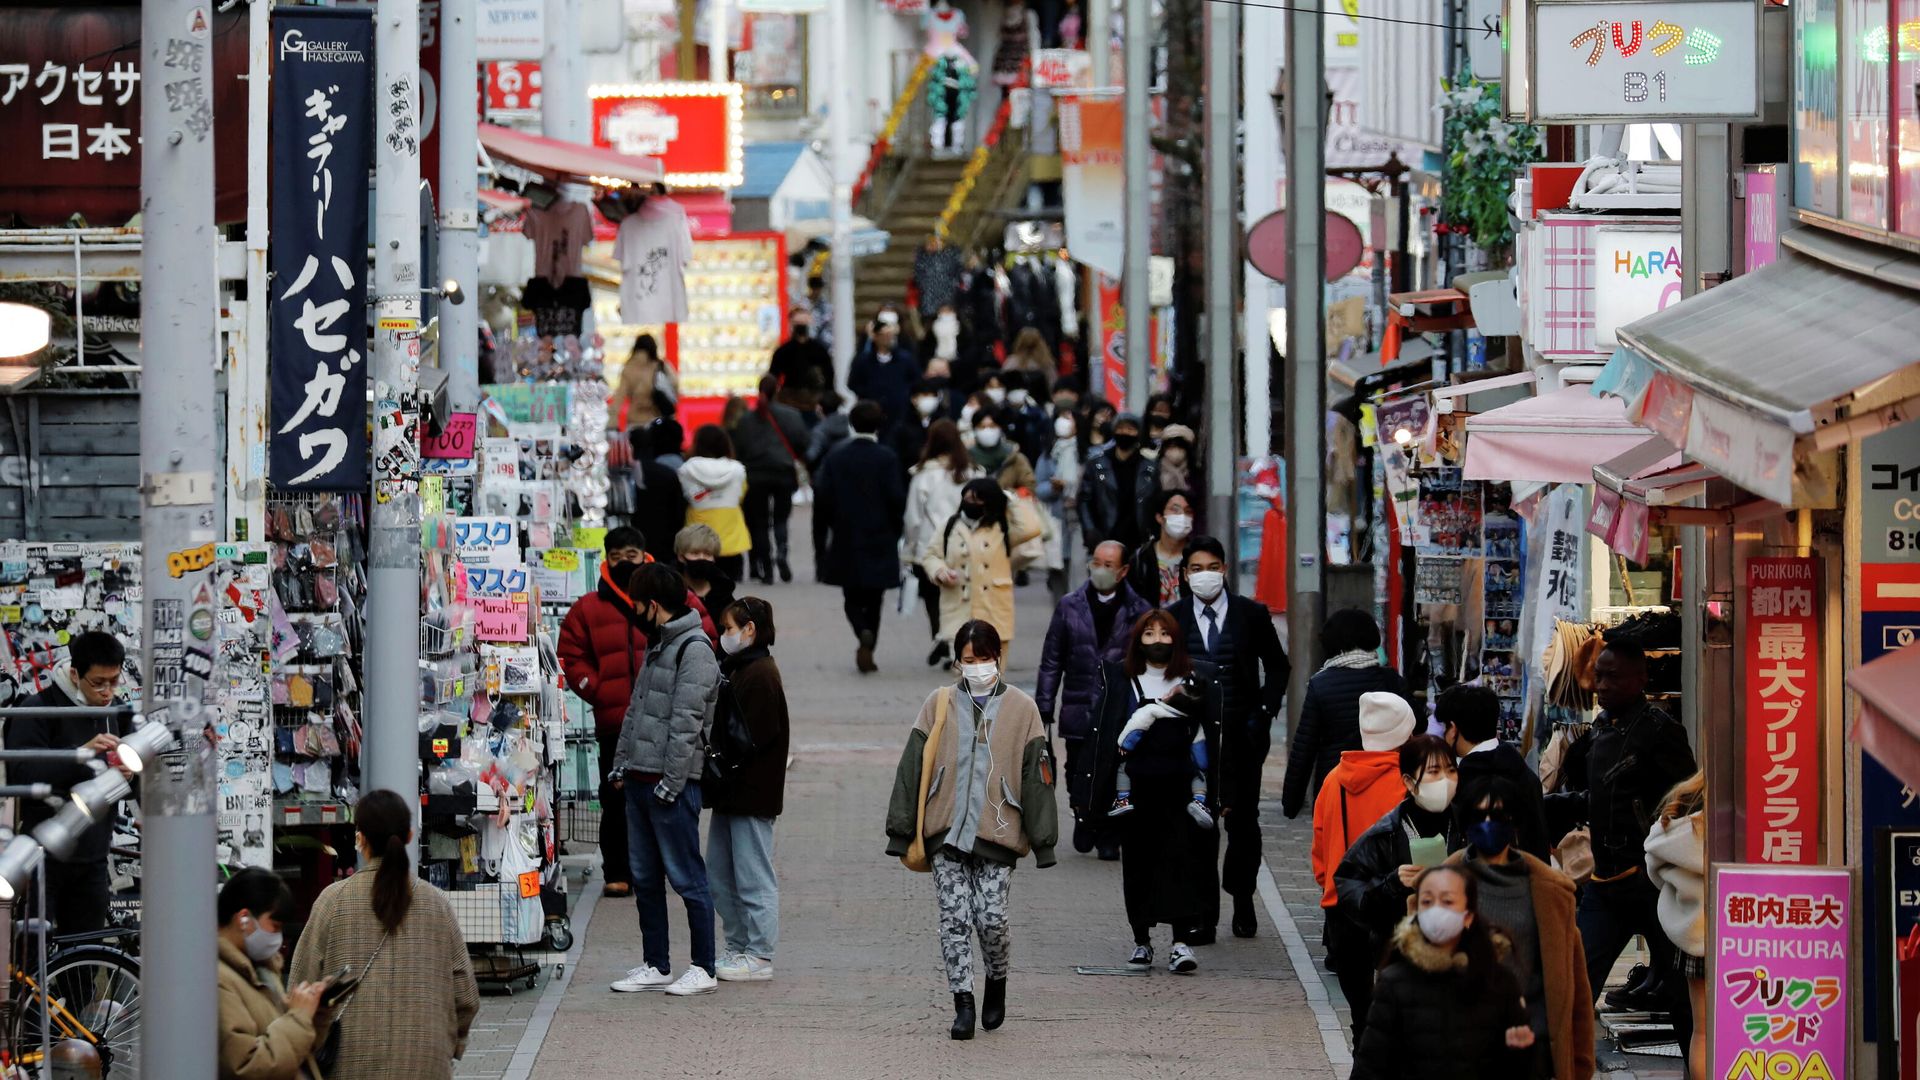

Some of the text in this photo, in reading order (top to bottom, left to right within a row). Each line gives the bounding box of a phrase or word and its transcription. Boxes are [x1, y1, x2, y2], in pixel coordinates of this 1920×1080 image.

[308, 41, 348, 51] GALLERY
[308, 52, 364, 63] HASEGAWA
[0, 60, 142, 106] アクセサ
[1623, 71, 1666, 103] B1
[43, 122, 143, 161] 日本
[304, 83, 348, 240] ギャラリー
[1615, 246, 1681, 278] HARA
[404, 299, 413, 311] 2
[277, 253, 361, 485] ハセガワ
[456, 522, 511, 546] マスク
[467, 568, 527, 593] マスク
[1751, 564, 1812, 580] PURIKURA
[1751, 586, 1813, 617] 都内
[474, 621, 509, 636] Murah
[1758, 623, 1806, 862] 最大プリクラ店
[1727, 895, 1842, 926] 都内最大
[1721, 937, 1845, 960] PURIKURA
[1725, 968, 1842, 1009] プリクラ
[1744, 1014, 1821, 1044] ランド
[1726, 1050, 1836, 1080] NOA
